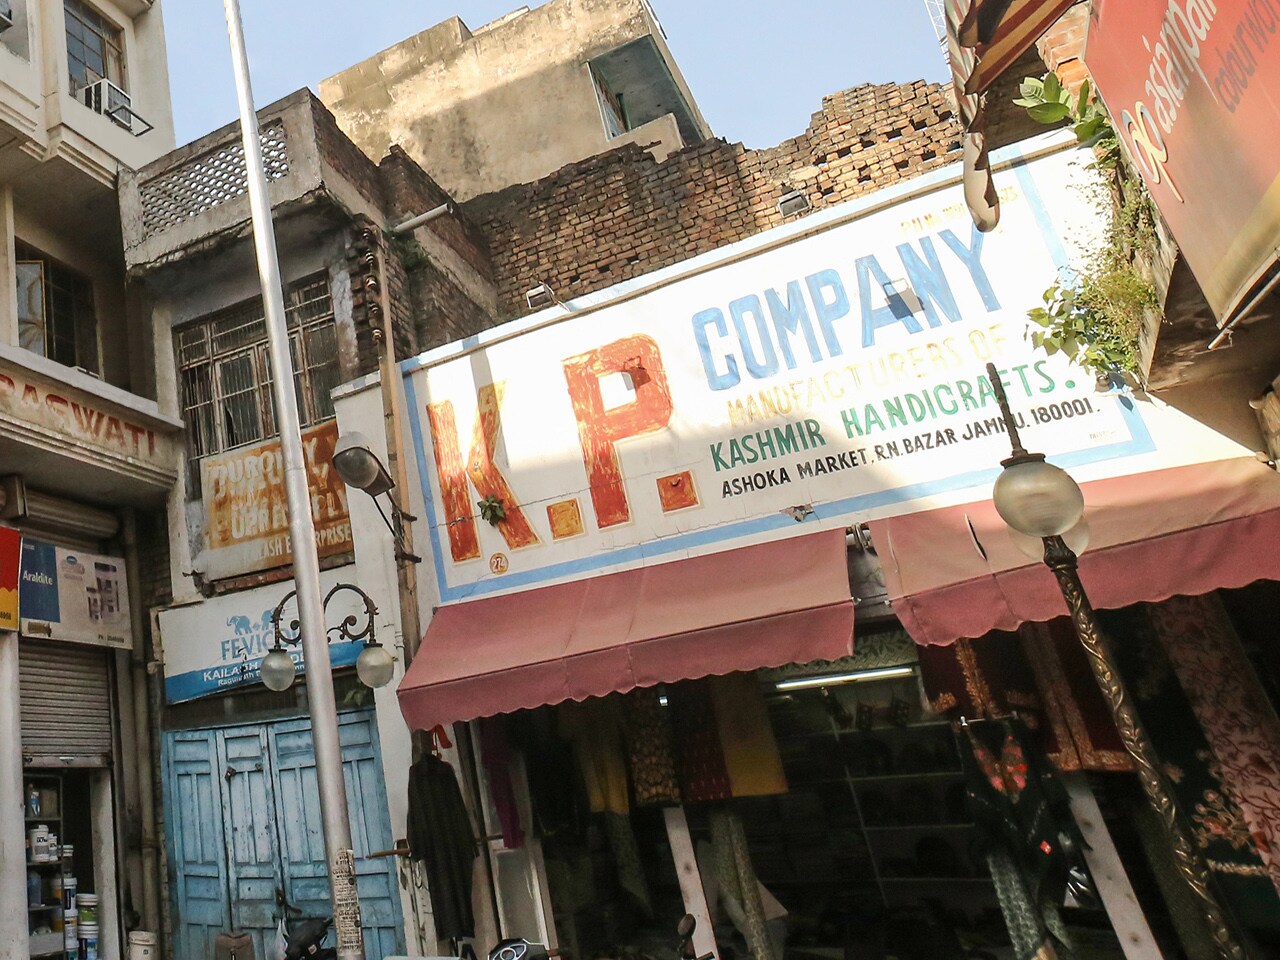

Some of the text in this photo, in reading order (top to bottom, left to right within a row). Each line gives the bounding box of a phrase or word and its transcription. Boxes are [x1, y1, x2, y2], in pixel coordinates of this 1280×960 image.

[691, 220, 1002, 391] COMPANY
[710, 418, 826, 472] KASHMIR
[722, 467, 791, 499] ASHOKA
[22, 570, 53, 586] Araldite
[491, 557, 507, 573] 274
